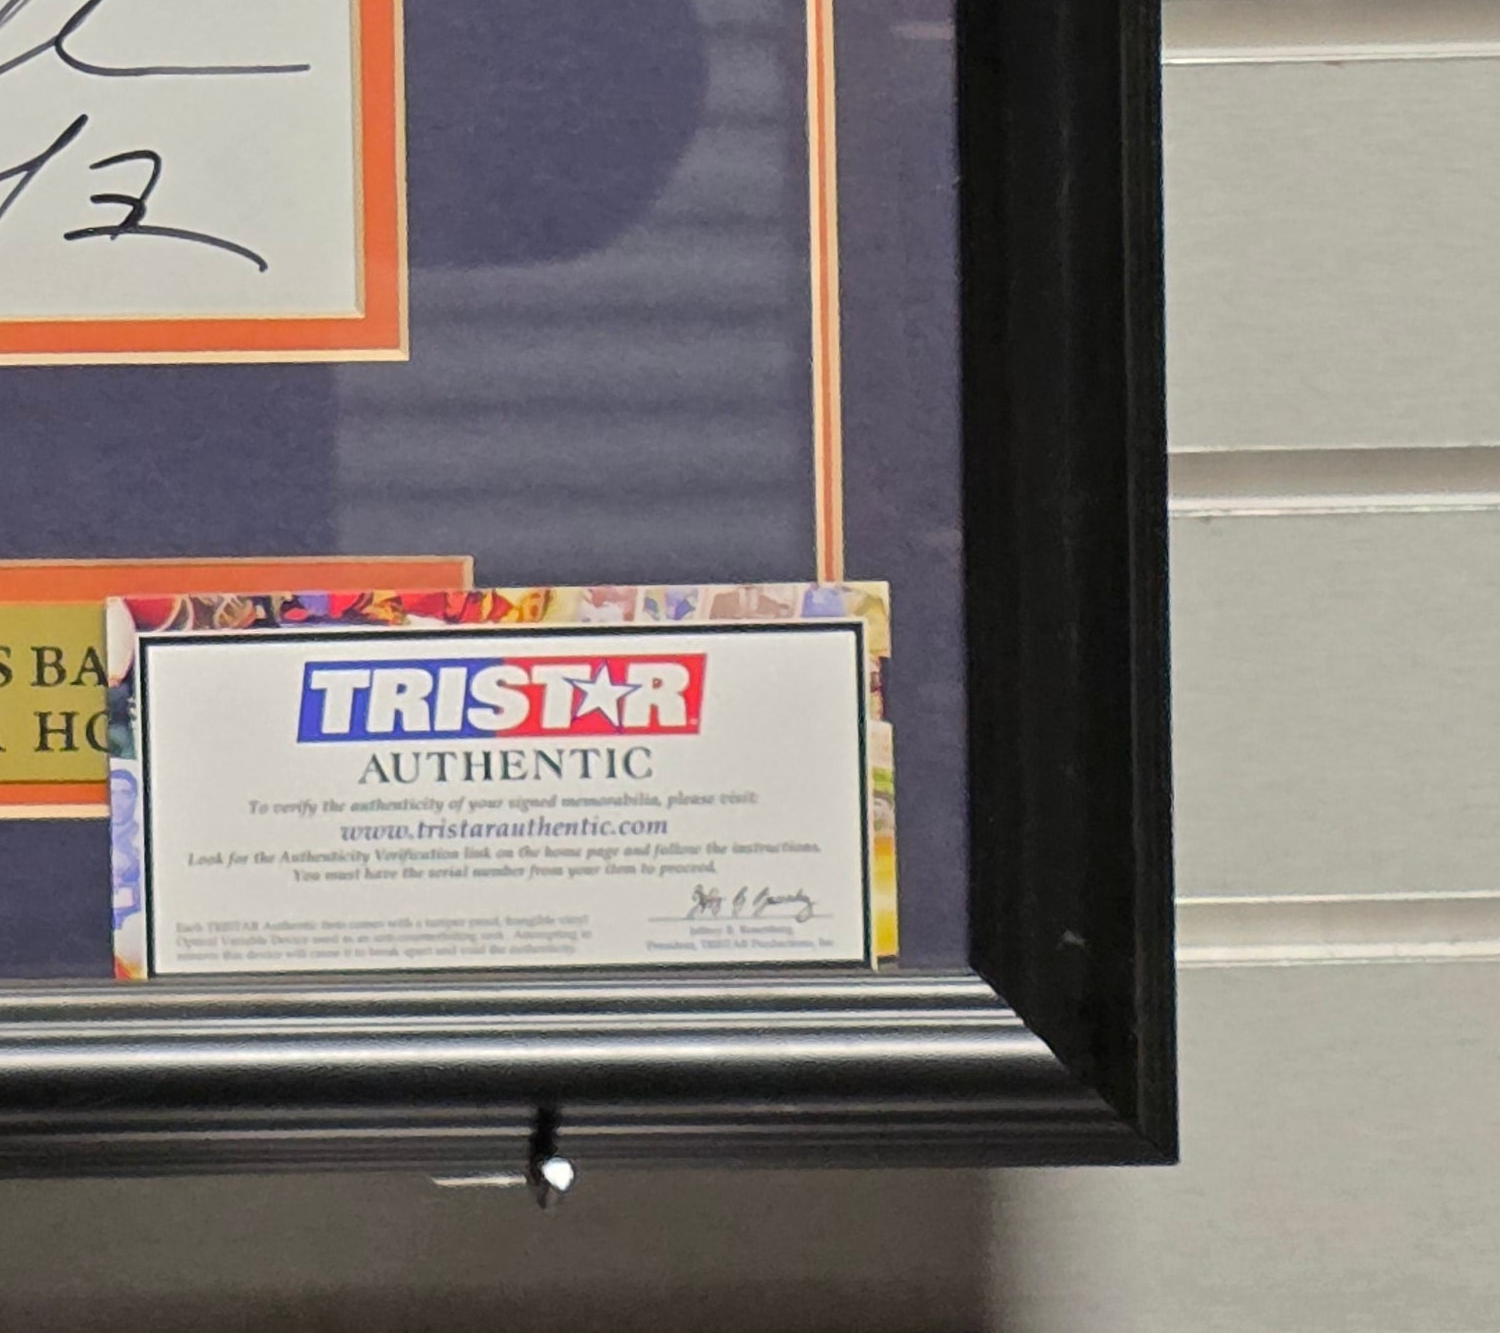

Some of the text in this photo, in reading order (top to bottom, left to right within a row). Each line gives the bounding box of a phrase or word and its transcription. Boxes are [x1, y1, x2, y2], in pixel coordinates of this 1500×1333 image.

[357, 745, 654, 785] AUTHENTIC
[249, 800, 268, 815] To
[273, 798, 318, 817] verify
[322, 797, 345, 813] the
[349, 796, 445, 814] authenticity
[448, 796, 466, 812] of
[468, 799, 504, 815] your
[508, 795, 558, 813] signed
[666, 791, 715, 809] please
[340, 814, 669, 842] www.tristarauthentic.com
[187, 852, 224, 867] Look
[227, 851, 249, 868] for
[254, 850, 276, 865] the
[280, 848, 370, 865] Authenticity
[374, 847, 459, 864] Verification
[463, 846, 491, 860] link
[518, 845, 540, 859] the
[623, 843, 651, 857] and
[705, 841, 728, 856] the
[402, 866, 424, 880] the
